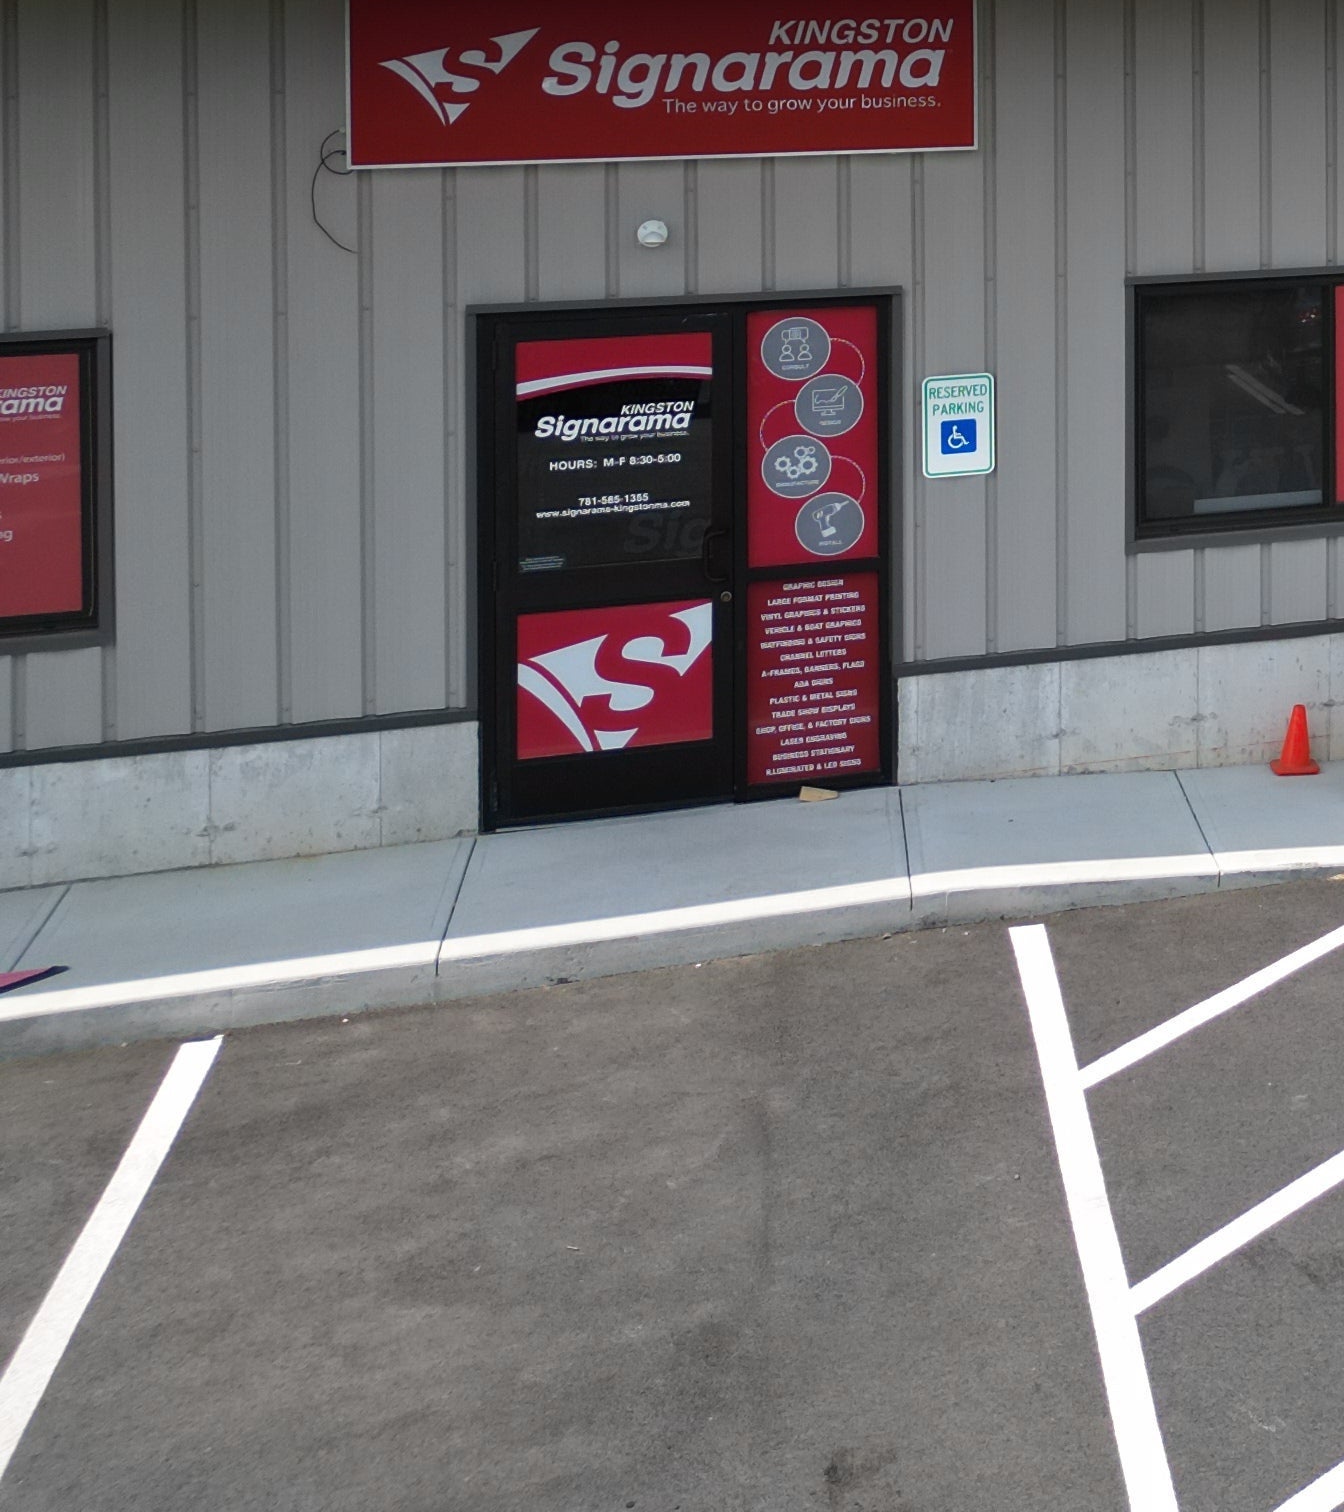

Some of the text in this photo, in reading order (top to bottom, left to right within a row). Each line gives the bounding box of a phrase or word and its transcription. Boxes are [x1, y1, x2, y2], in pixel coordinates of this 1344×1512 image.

[768, 18, 954, 46] KINGSTON
[542, 39, 946, 109] Signarama
[662, 94, 942, 116] The way to grow your business.
[928, 384, 988, 400] RESERVED
[621, 401, 694, 415] KINGSTON
[932, 401, 984, 416] PARKING
[534, 412, 692, 441] Signarama
[549, 459, 597, 471] HOURS:
